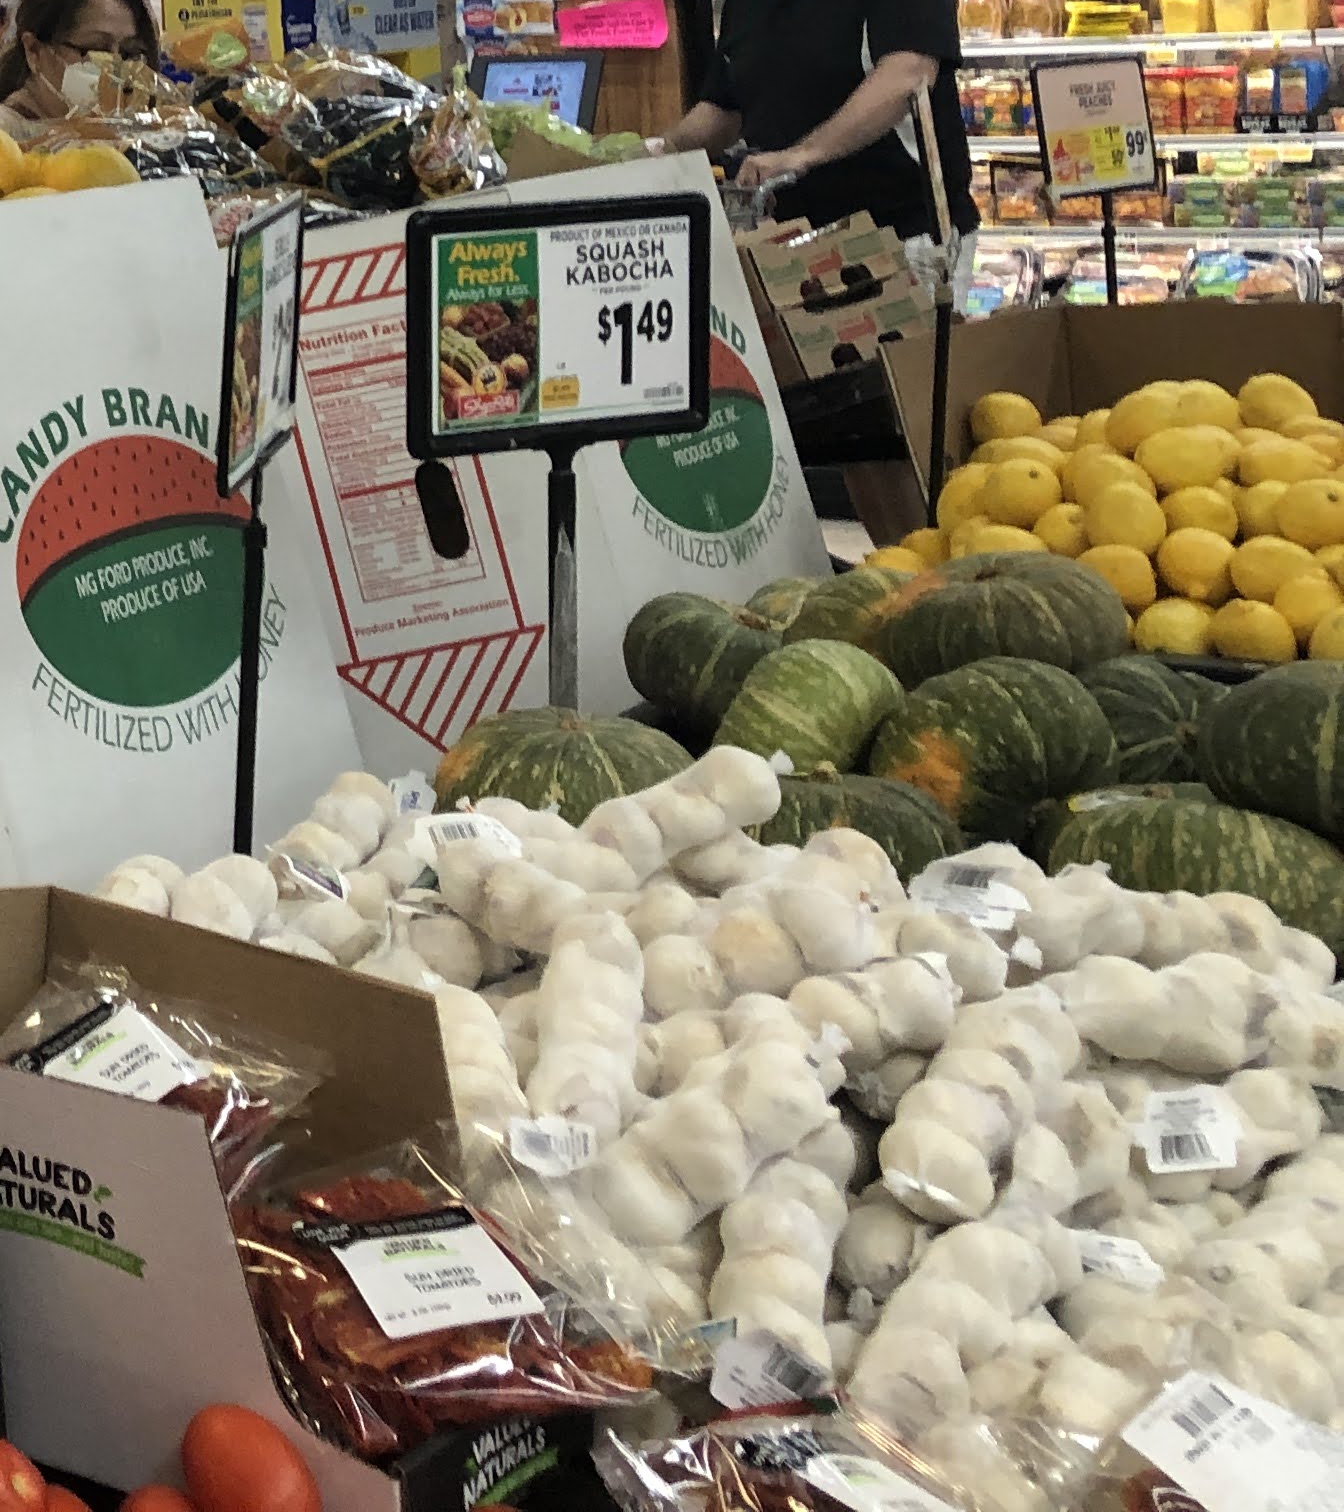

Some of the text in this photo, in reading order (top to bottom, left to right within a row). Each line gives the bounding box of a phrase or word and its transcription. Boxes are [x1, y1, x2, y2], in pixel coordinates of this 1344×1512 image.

[550, 222, 688, 242] PRODUCT OF MEXICO OR CANADA
[449, 240, 528, 264] Always
[576, 239, 666, 264] SQUASH
[457, 263, 520, 288] Fresh.
[566, 259, 675, 286] KABOCHA
[445, 287, 486, 303] Always
[299, 320, 408, 352] Nutrition Fact
[101, 387, 211, 449] BRAN
[632, 453, 790, 569] FERTILIZED WITH HONEY
[75, 535, 214, 600] MG FORD PRODUCE, INC.
[101, 570, 207, 624] PRODUCE OF USA
[355, 597, 509, 638] Produce Marketing Association
[31, 583, 288, 753] FERTILIZED WITH ONEY
[404, 1265, 475, 1283] SUN DRIED
[413, 1275, 482, 1294] TOMATOES
[463, 1425, 546, 1512] NATURALS
